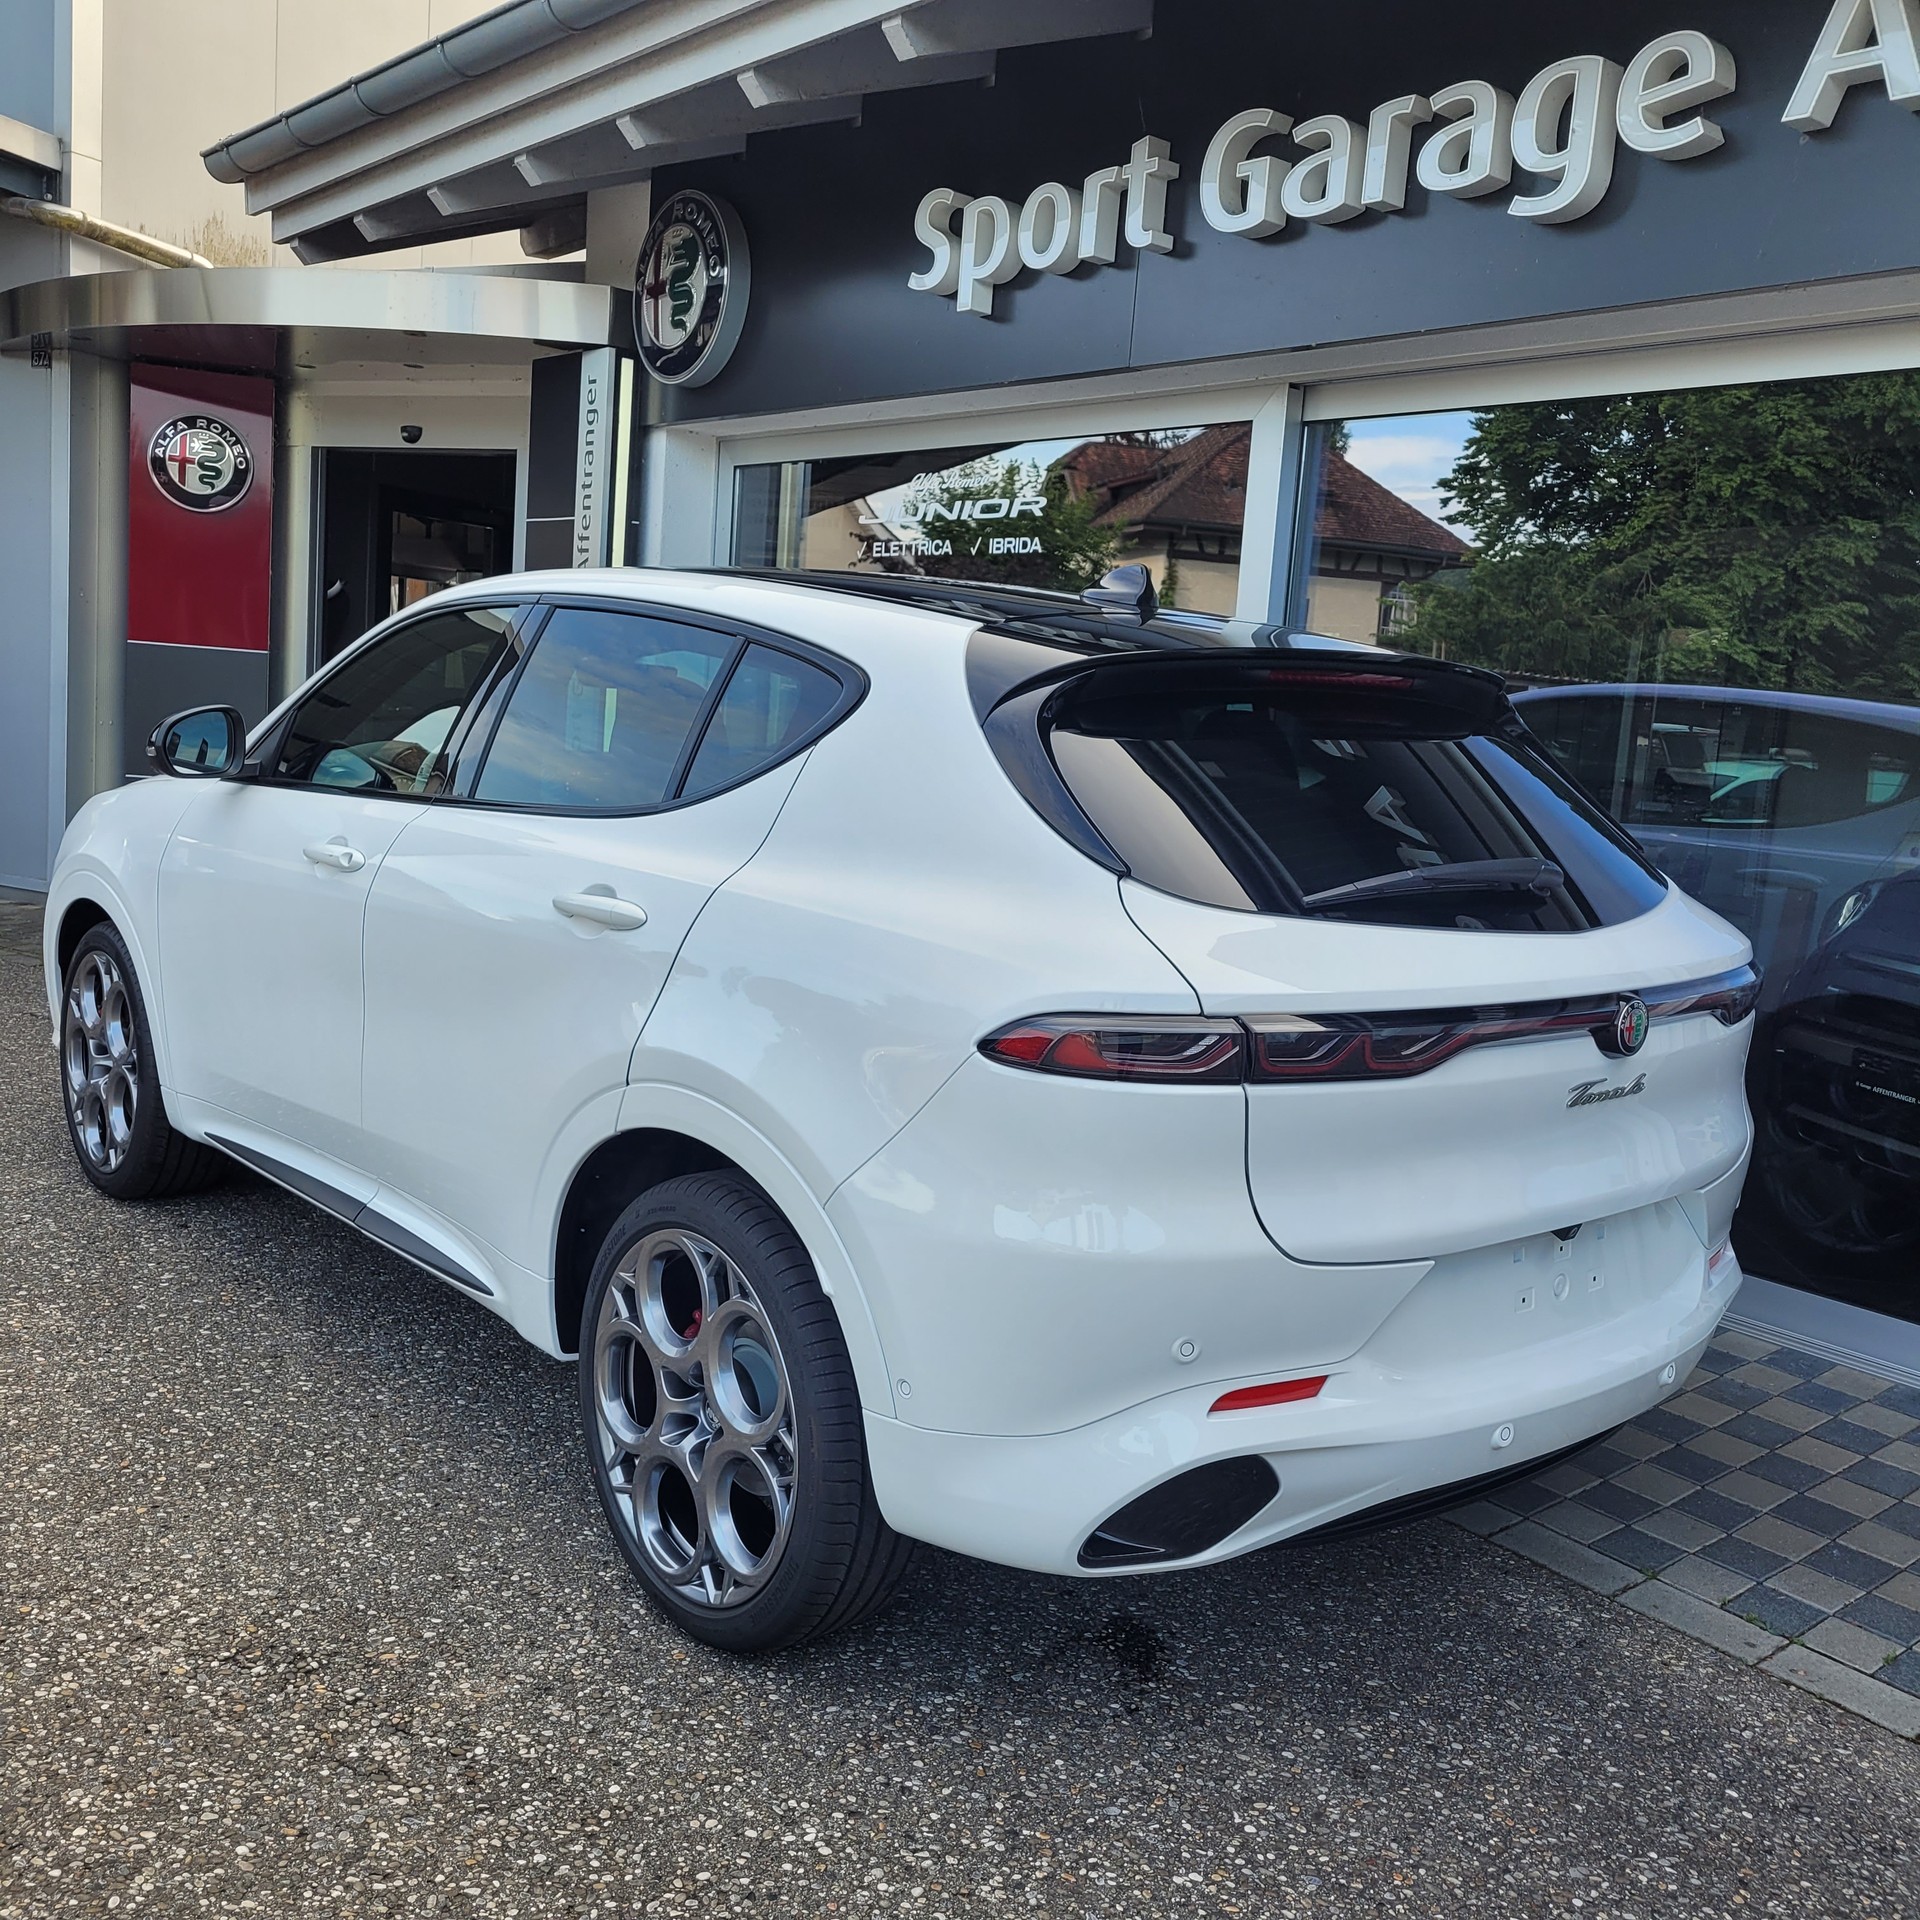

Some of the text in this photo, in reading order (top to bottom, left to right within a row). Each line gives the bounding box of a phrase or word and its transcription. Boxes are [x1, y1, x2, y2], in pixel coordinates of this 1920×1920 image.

[907, 135, 1179, 315] Sport
[1200, 30, 1737, 239] Garage
[637, 202, 720, 296] ALFA ROMEO
[154, 418, 246, 469] ALFA ROMEO
[858, 496, 1047, 525] JUNIOR
[872, 536, 1042, 558] ELETTRICA IBRIDA
[1566, 1072, 1647, 1108] Tonale
